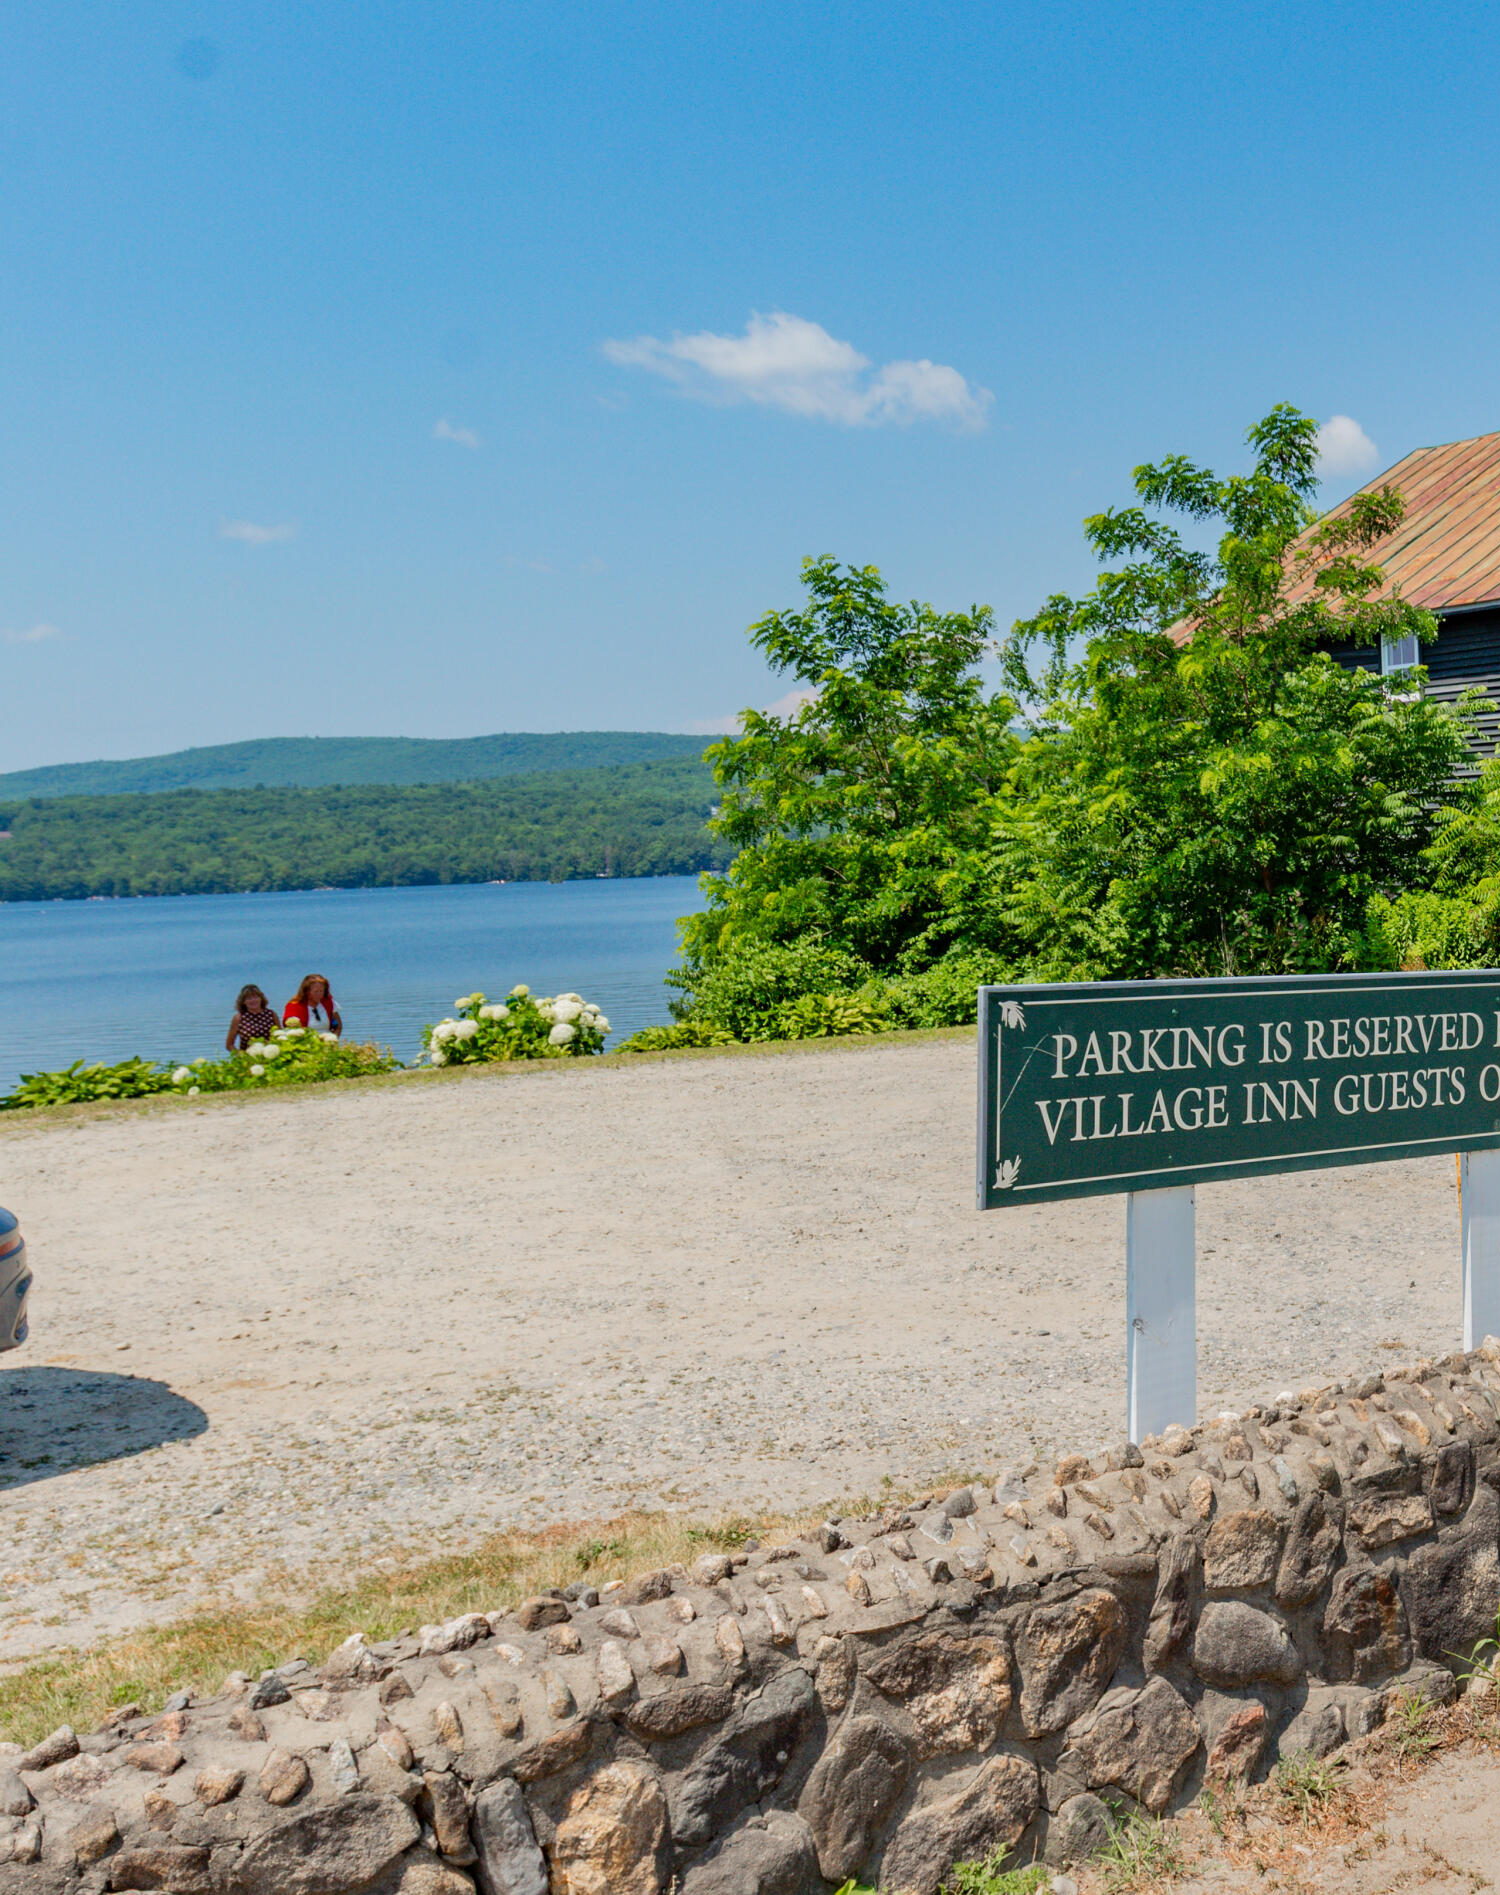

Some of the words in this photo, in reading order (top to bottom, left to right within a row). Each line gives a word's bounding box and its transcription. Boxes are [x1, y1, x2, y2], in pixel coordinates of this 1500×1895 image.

[1051, 1025, 1247, 1079] PARKING
[1258, 1021, 1292, 1064] IS
[1303, 1012, 1484, 1061] RESERVED
[1034, 1085, 1230, 1146] VILLAGE
[1241, 1078, 1321, 1125] INN
[1333, 1066, 1466, 1115] GUESTS
